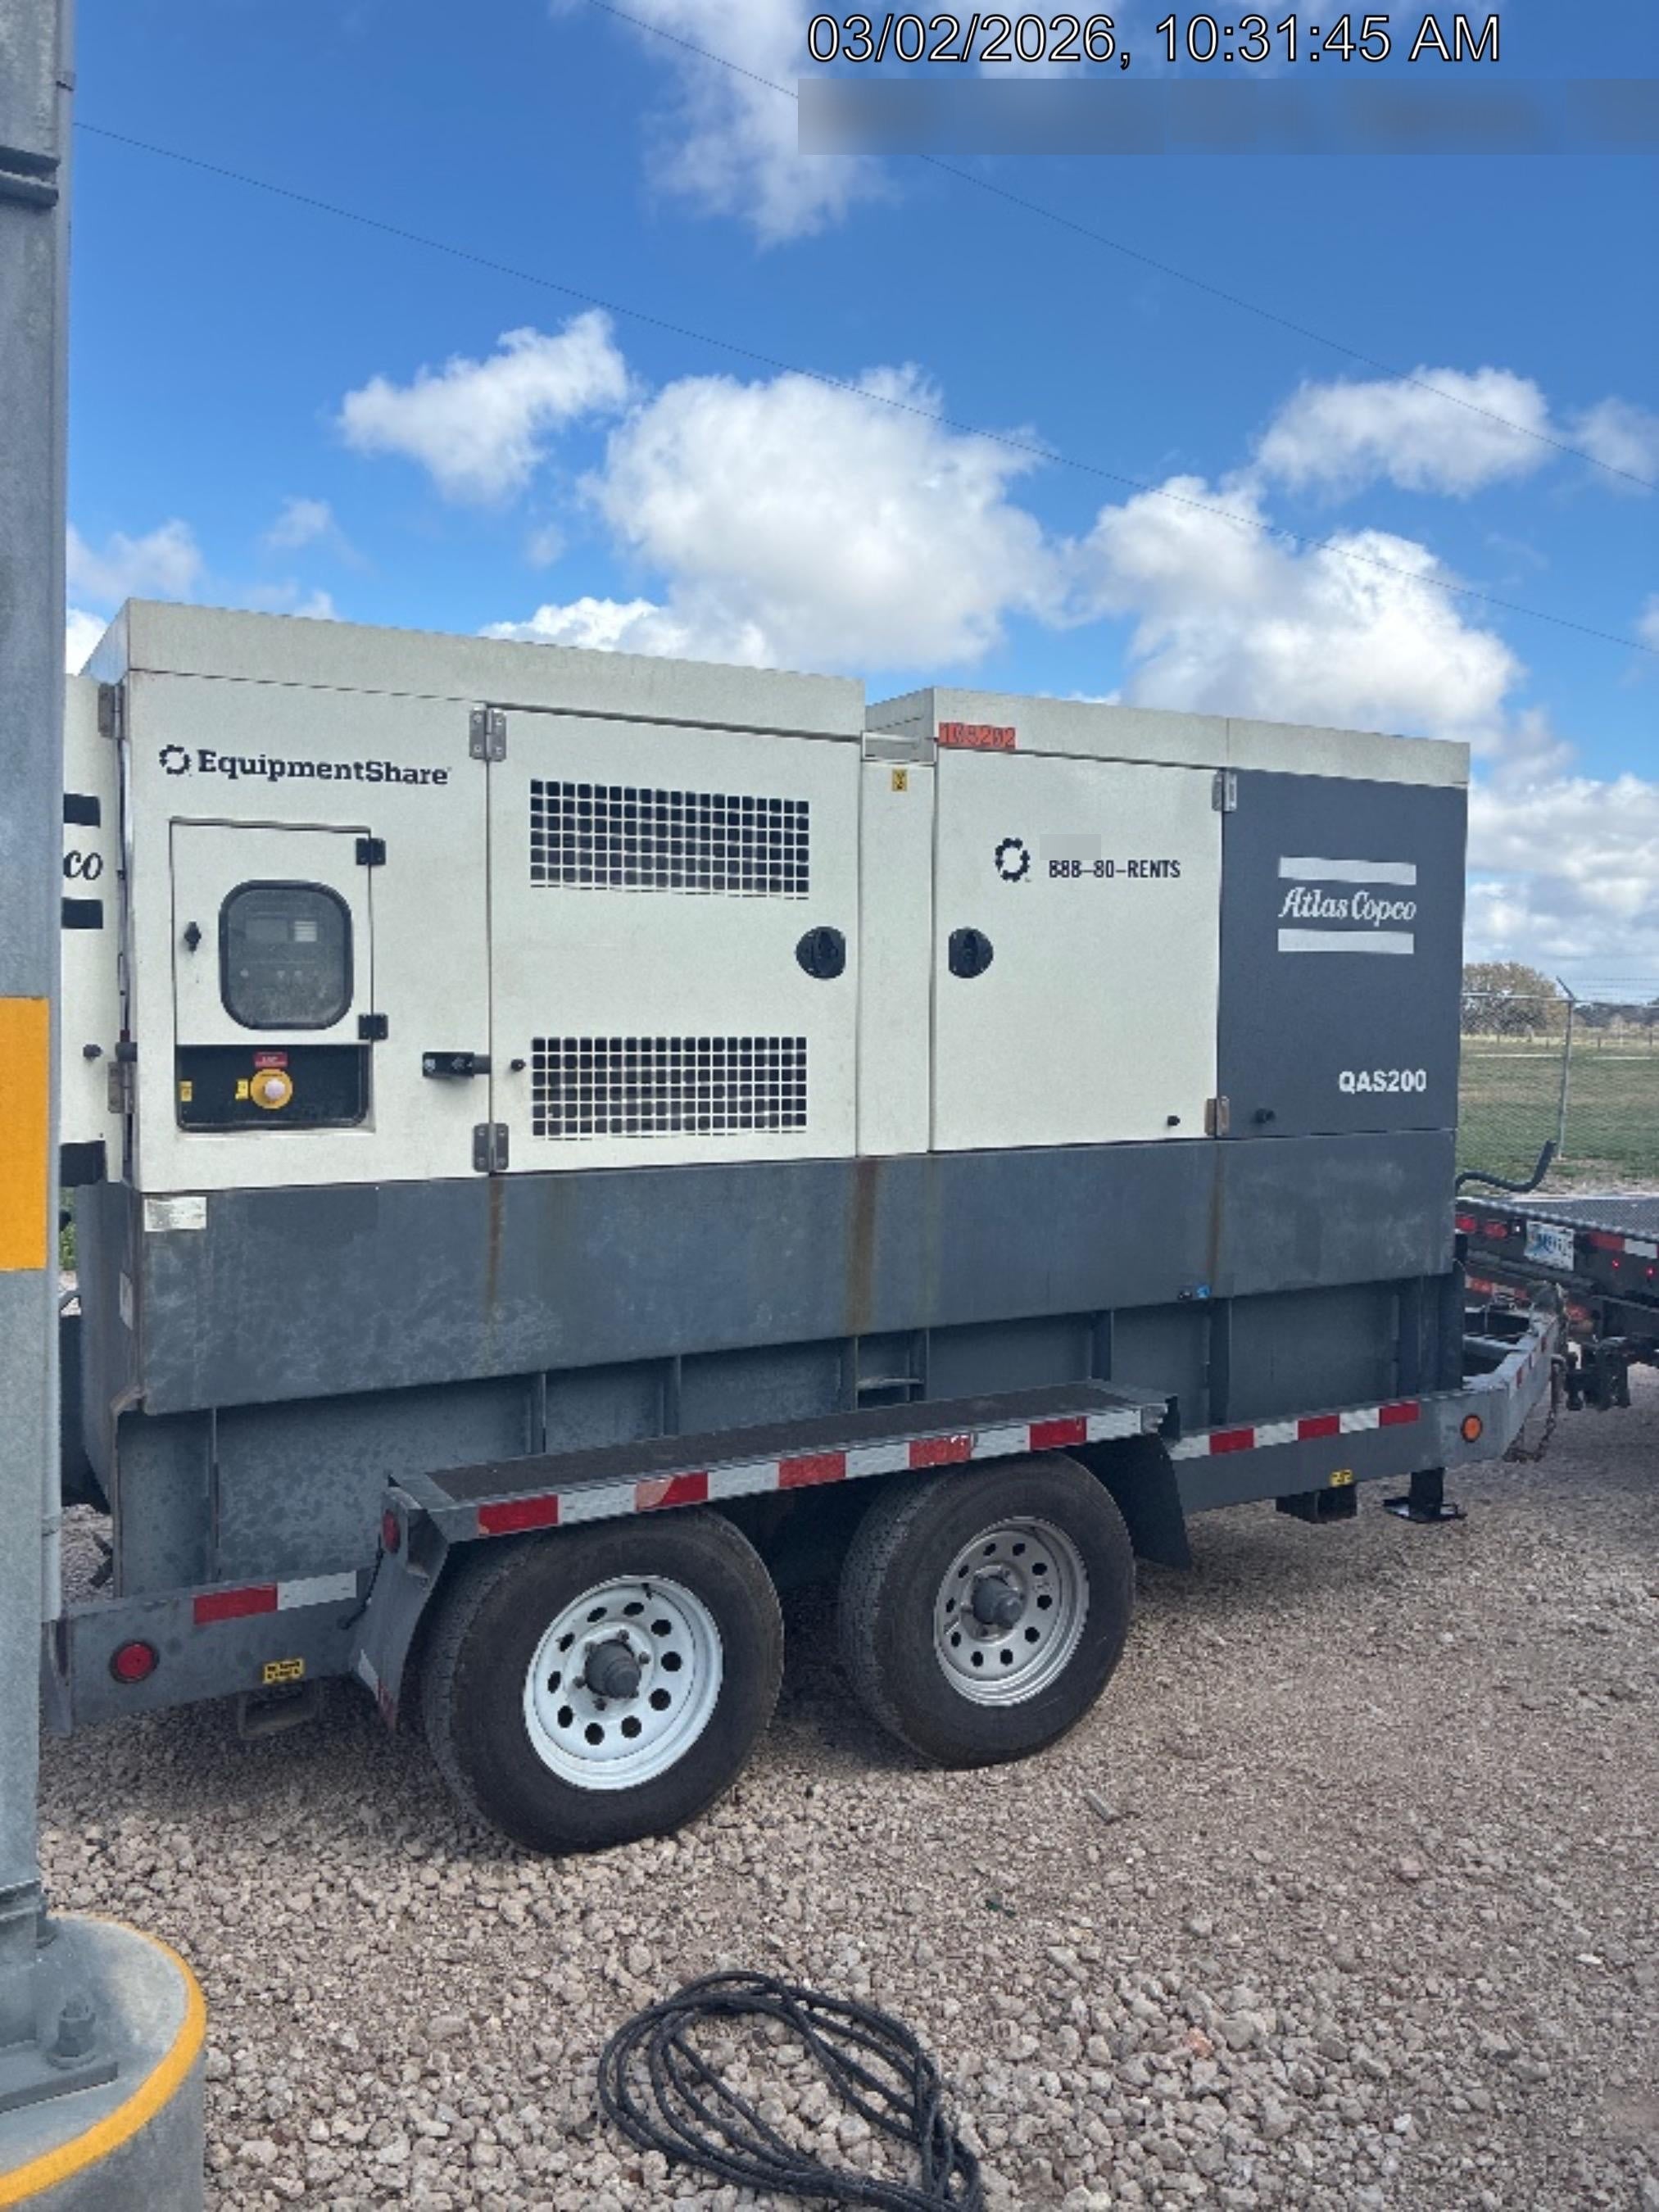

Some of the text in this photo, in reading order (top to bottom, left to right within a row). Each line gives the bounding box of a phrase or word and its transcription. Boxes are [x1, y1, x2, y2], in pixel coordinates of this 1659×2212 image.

[197, 749, 448, 785] EquipmentShare
[1049, 859, 1181, 878] 888-80-RENTS
[1277, 886, 1416, 927] Atlas Copco
[1339, 1069, 1427, 1094] QAS200
